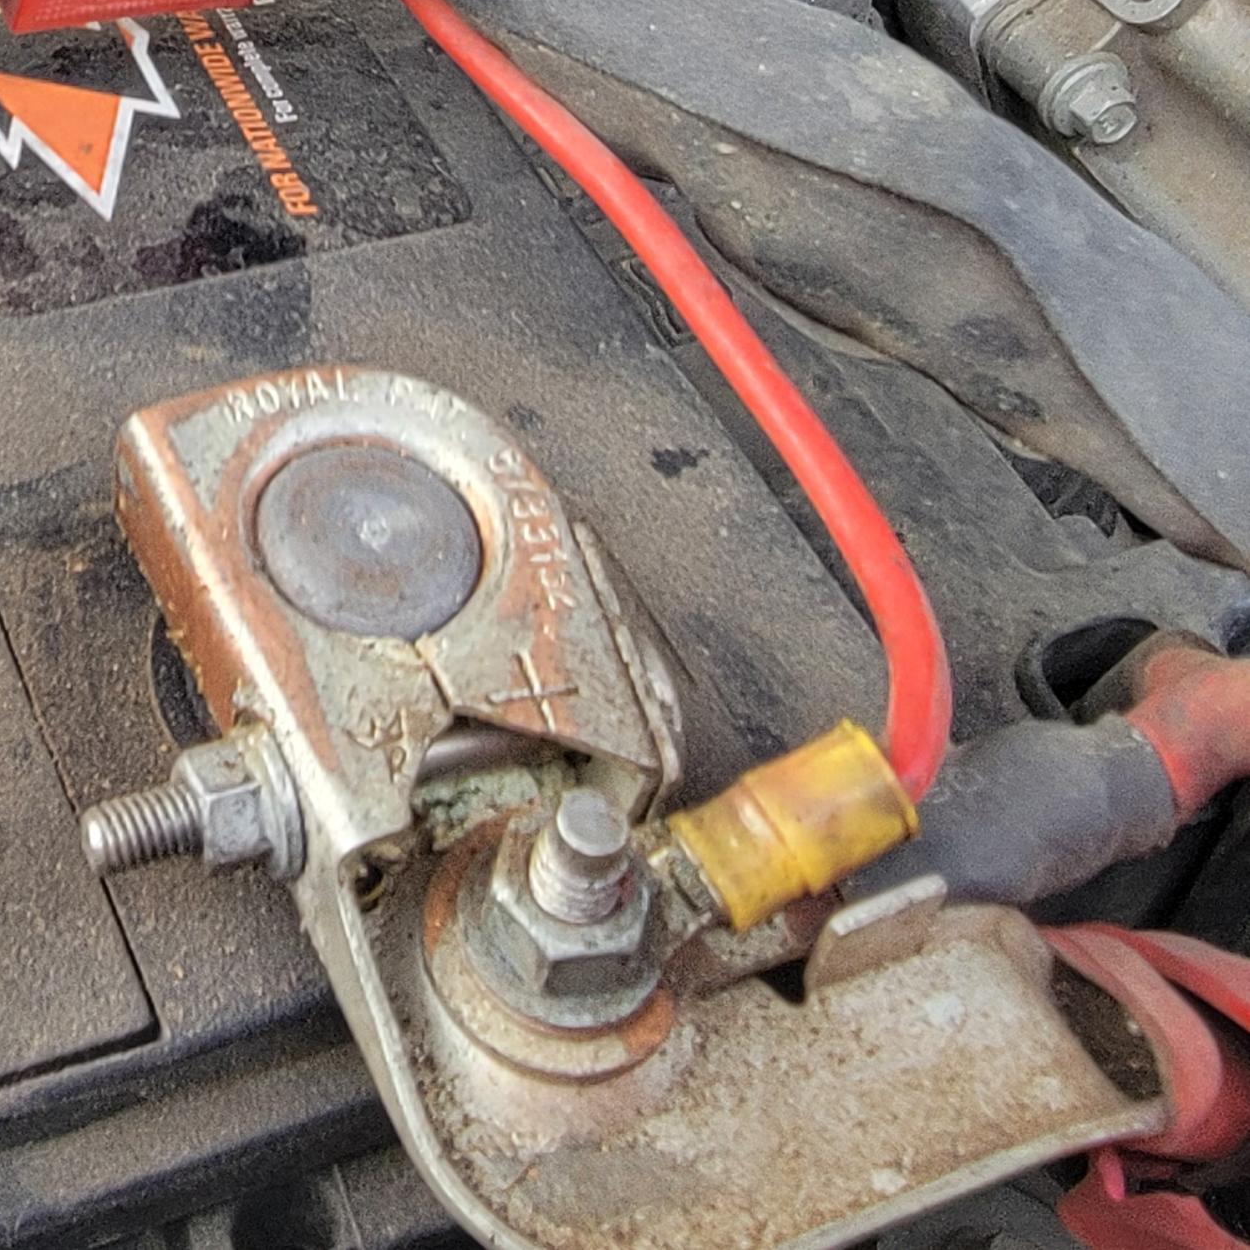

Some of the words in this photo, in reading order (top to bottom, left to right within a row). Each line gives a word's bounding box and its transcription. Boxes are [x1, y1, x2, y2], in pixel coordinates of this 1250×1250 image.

[194, 41, 293, 171] NATIONWIDE
[269, 171, 319, 217] FOR
[223, 367, 360, 428] ROYAL
